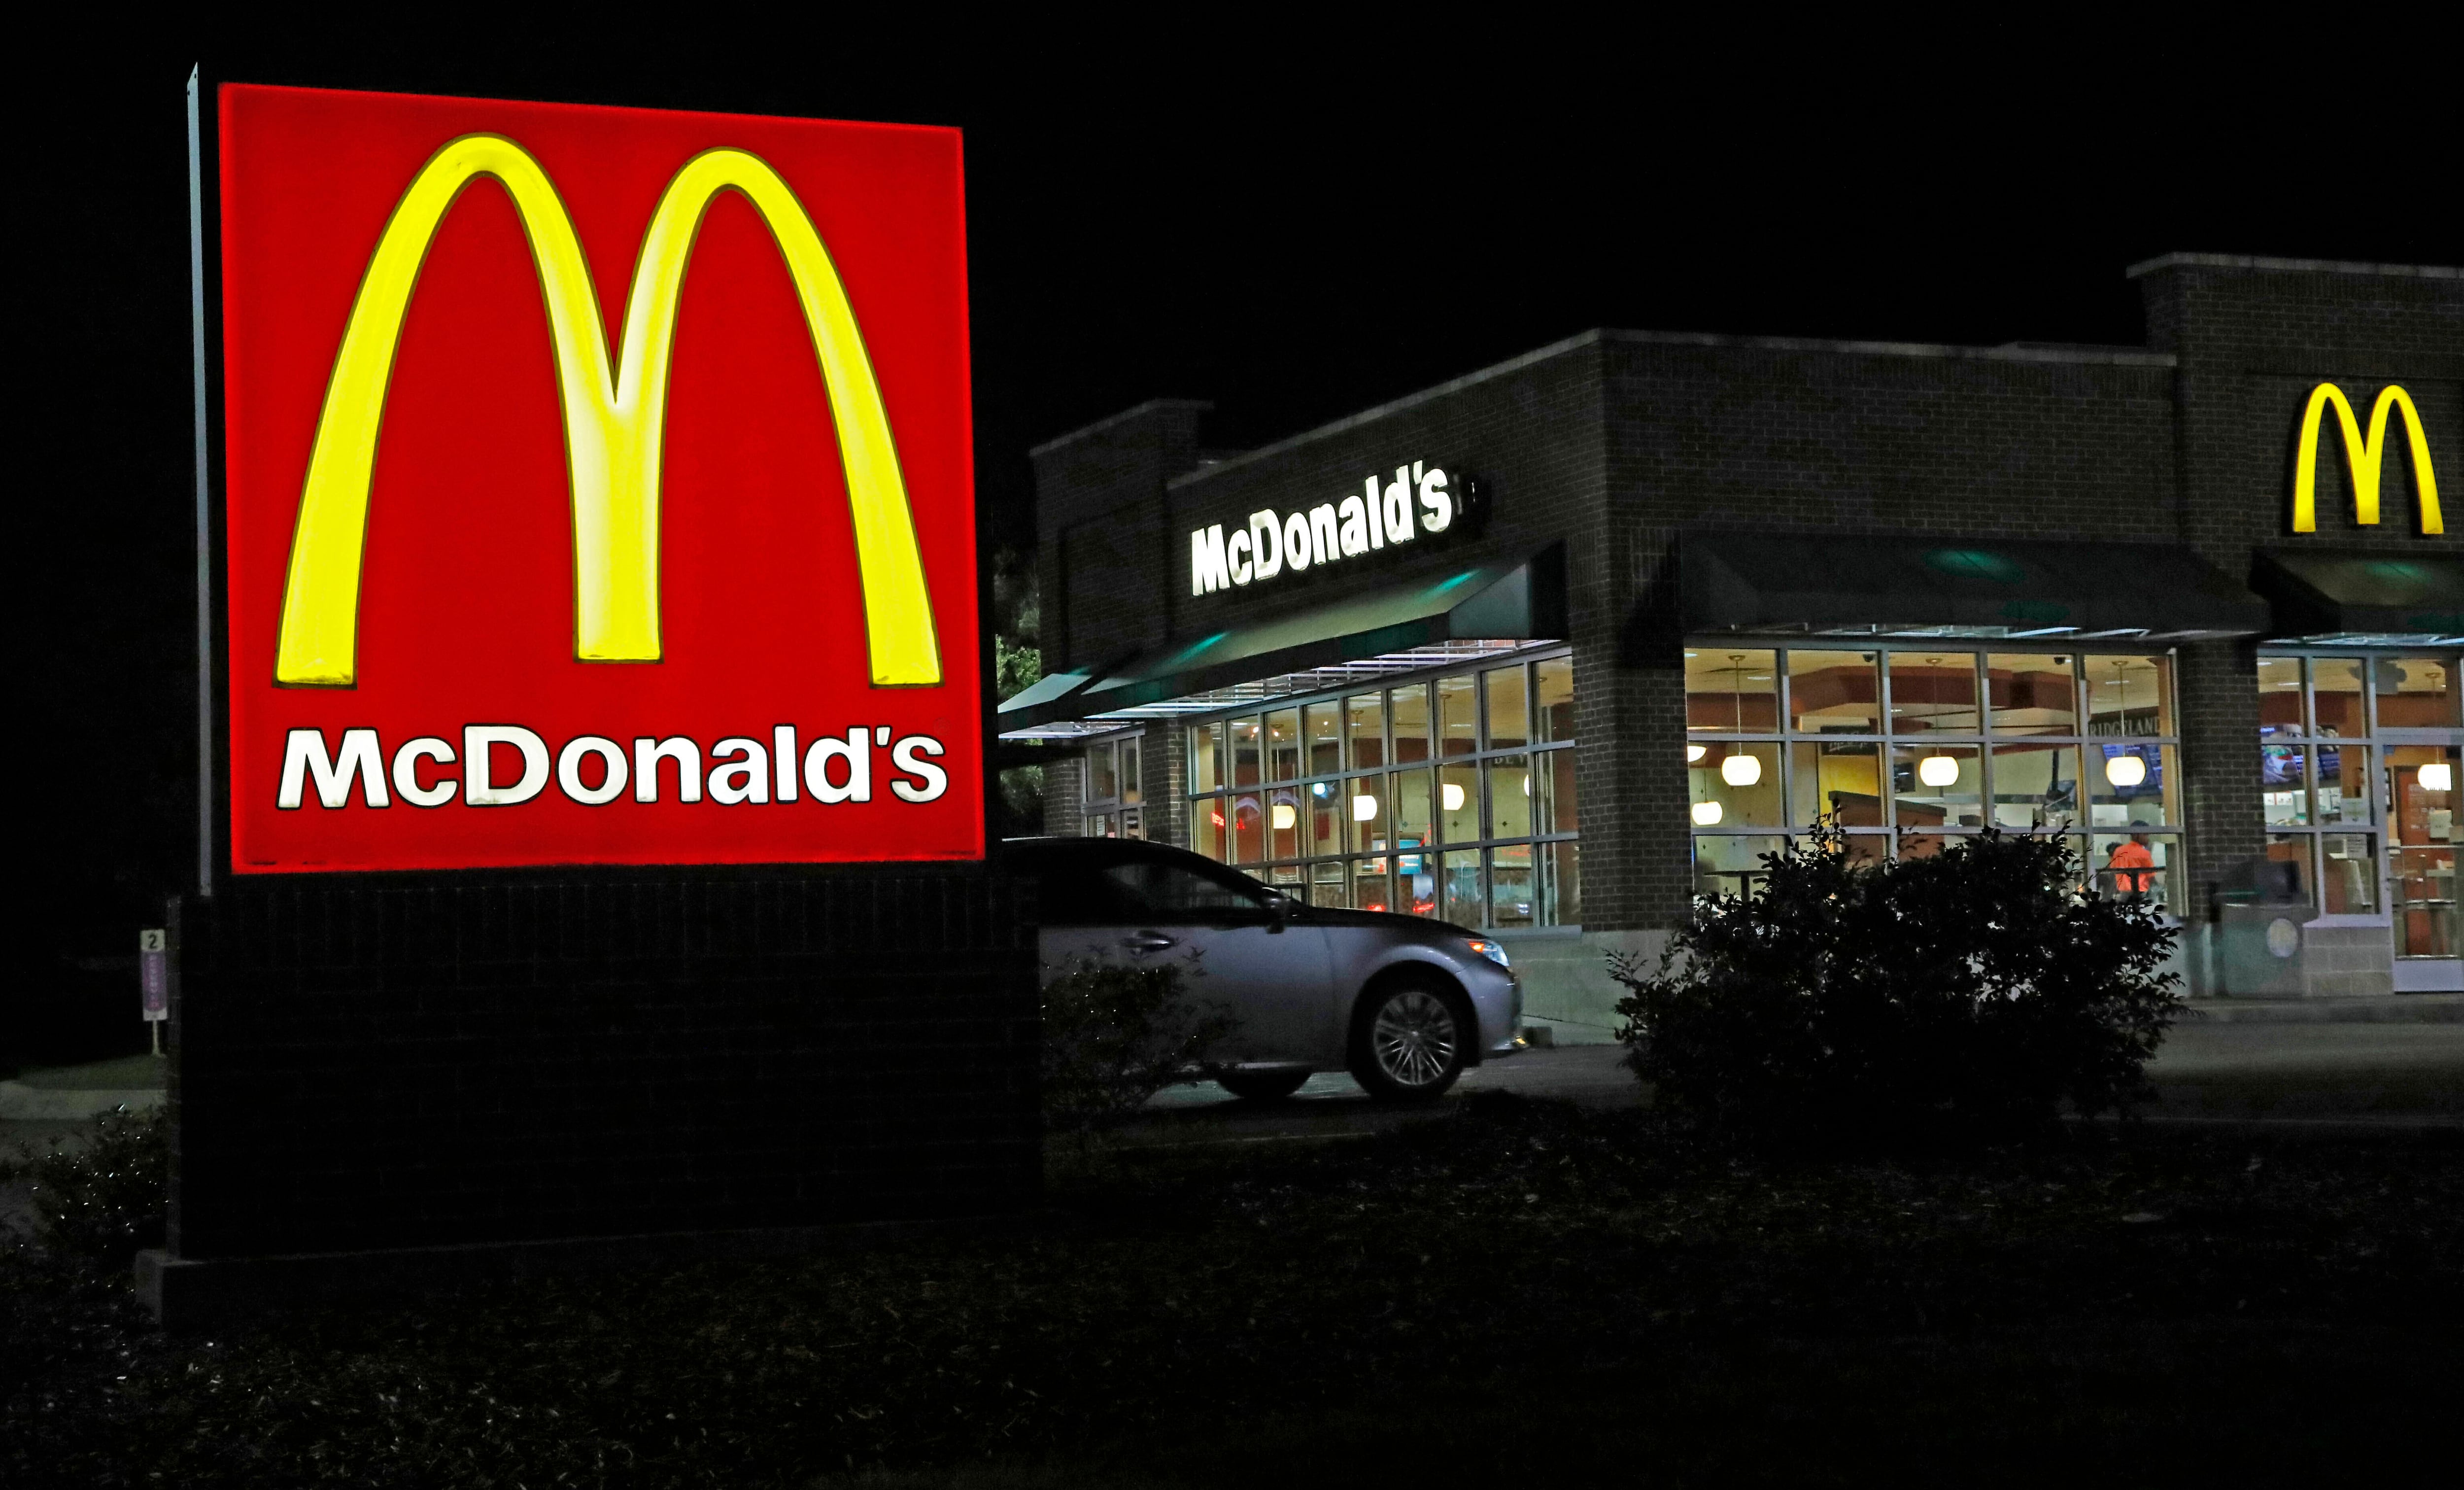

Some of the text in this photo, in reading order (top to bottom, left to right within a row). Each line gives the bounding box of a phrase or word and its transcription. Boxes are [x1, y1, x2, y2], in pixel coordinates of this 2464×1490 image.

[1192, 460, 1452, 596] McDonald's
[275, 723, 949, 809] McDonald's
[148, 934, 157, 949] 2
